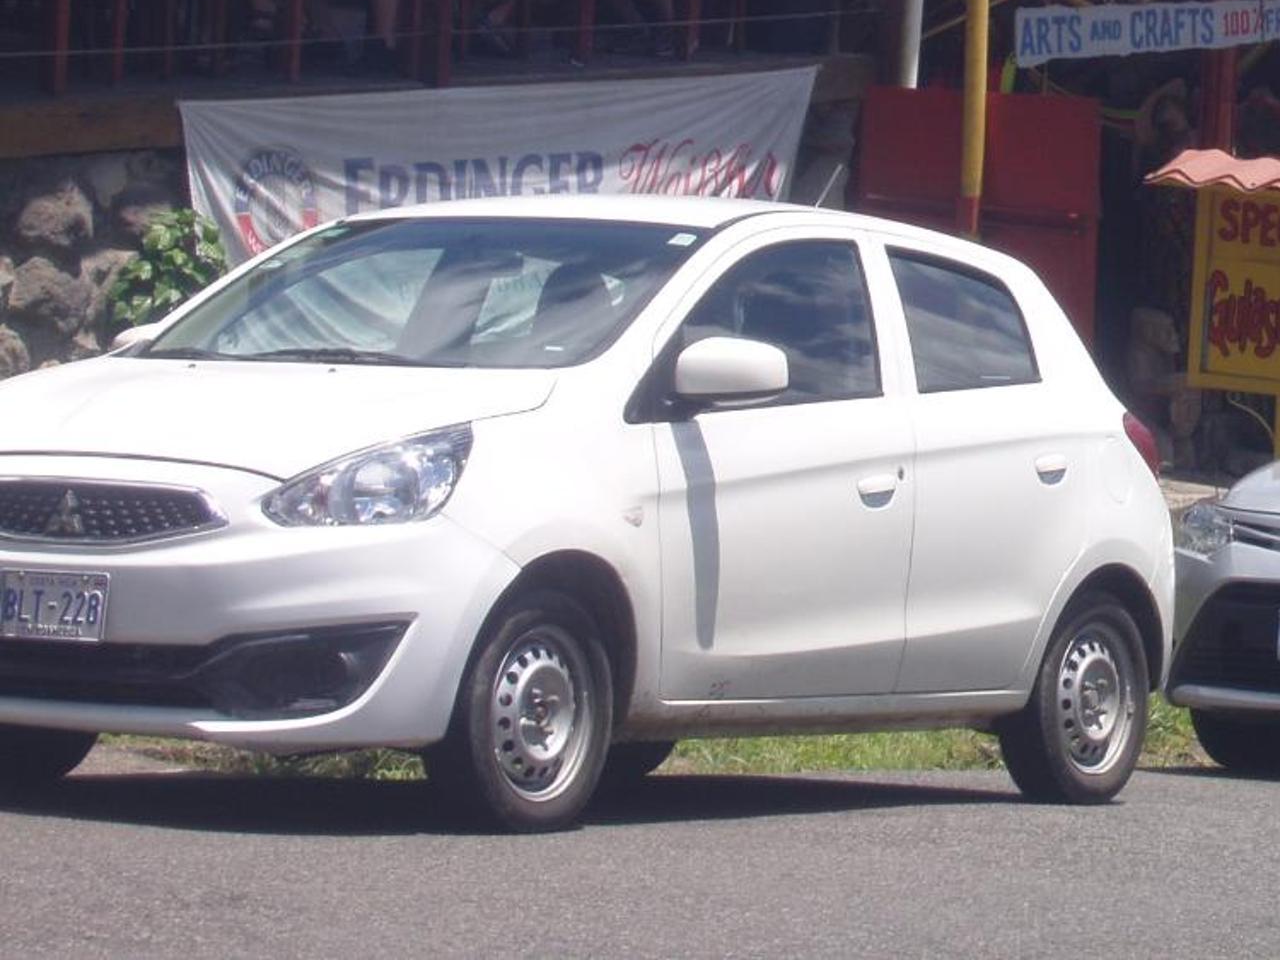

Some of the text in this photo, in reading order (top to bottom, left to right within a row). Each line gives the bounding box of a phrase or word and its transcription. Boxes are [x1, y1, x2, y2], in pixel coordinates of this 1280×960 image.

[1019, 14, 1083, 56] ARTS
[1089, 20, 1122, 41] AND
[1130, 7, 1215, 49] CRAFTS
